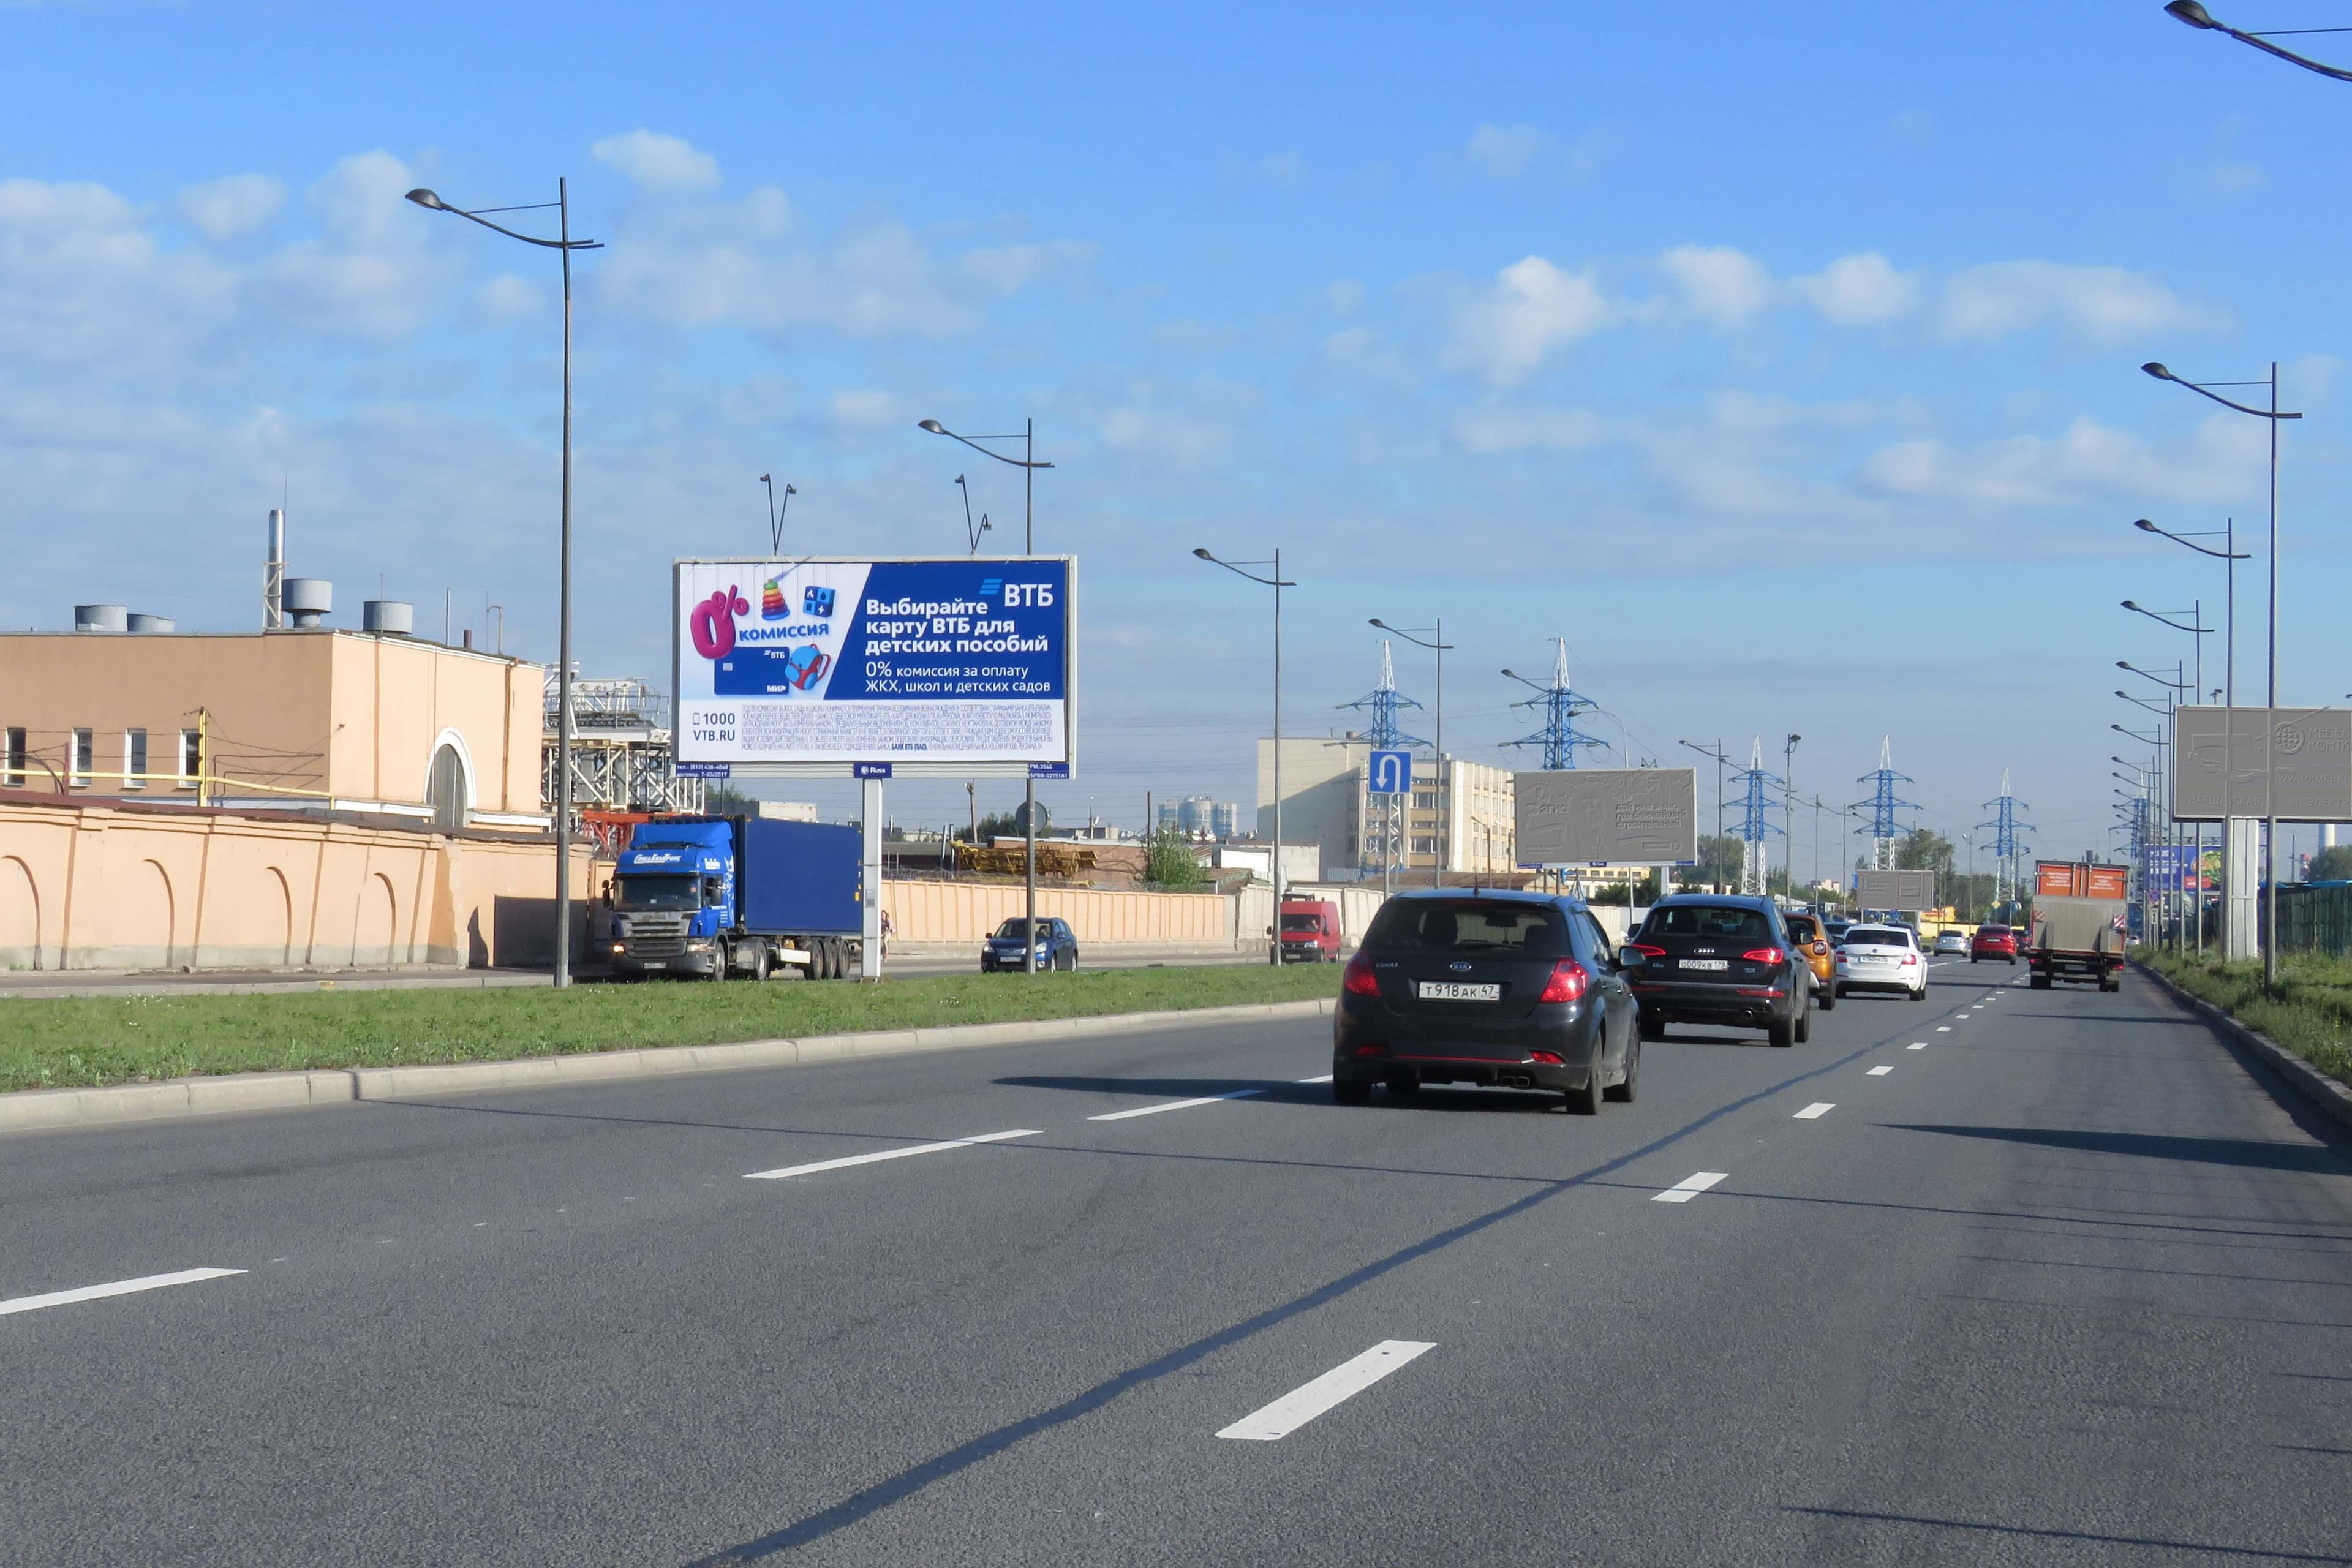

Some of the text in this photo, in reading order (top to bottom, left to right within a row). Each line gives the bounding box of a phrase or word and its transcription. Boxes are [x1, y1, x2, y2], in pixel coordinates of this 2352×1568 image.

[1005, 584, 1054, 607] ВТБ
[866, 598, 988, 618] Выбирайте
[690, 584, 750, 660] 0%
[866, 617, 1015, 638] карту ВТБ для
[865, 635, 1048, 655] детских пособий
[866, 662, 1028, 679] 0% комиссия за оплату
[865, 680, 1051, 693] ЖКХ, школ и детских садов
[704, 712, 735, 725] 1000
[693, 729, 735, 742] VTB.RU
